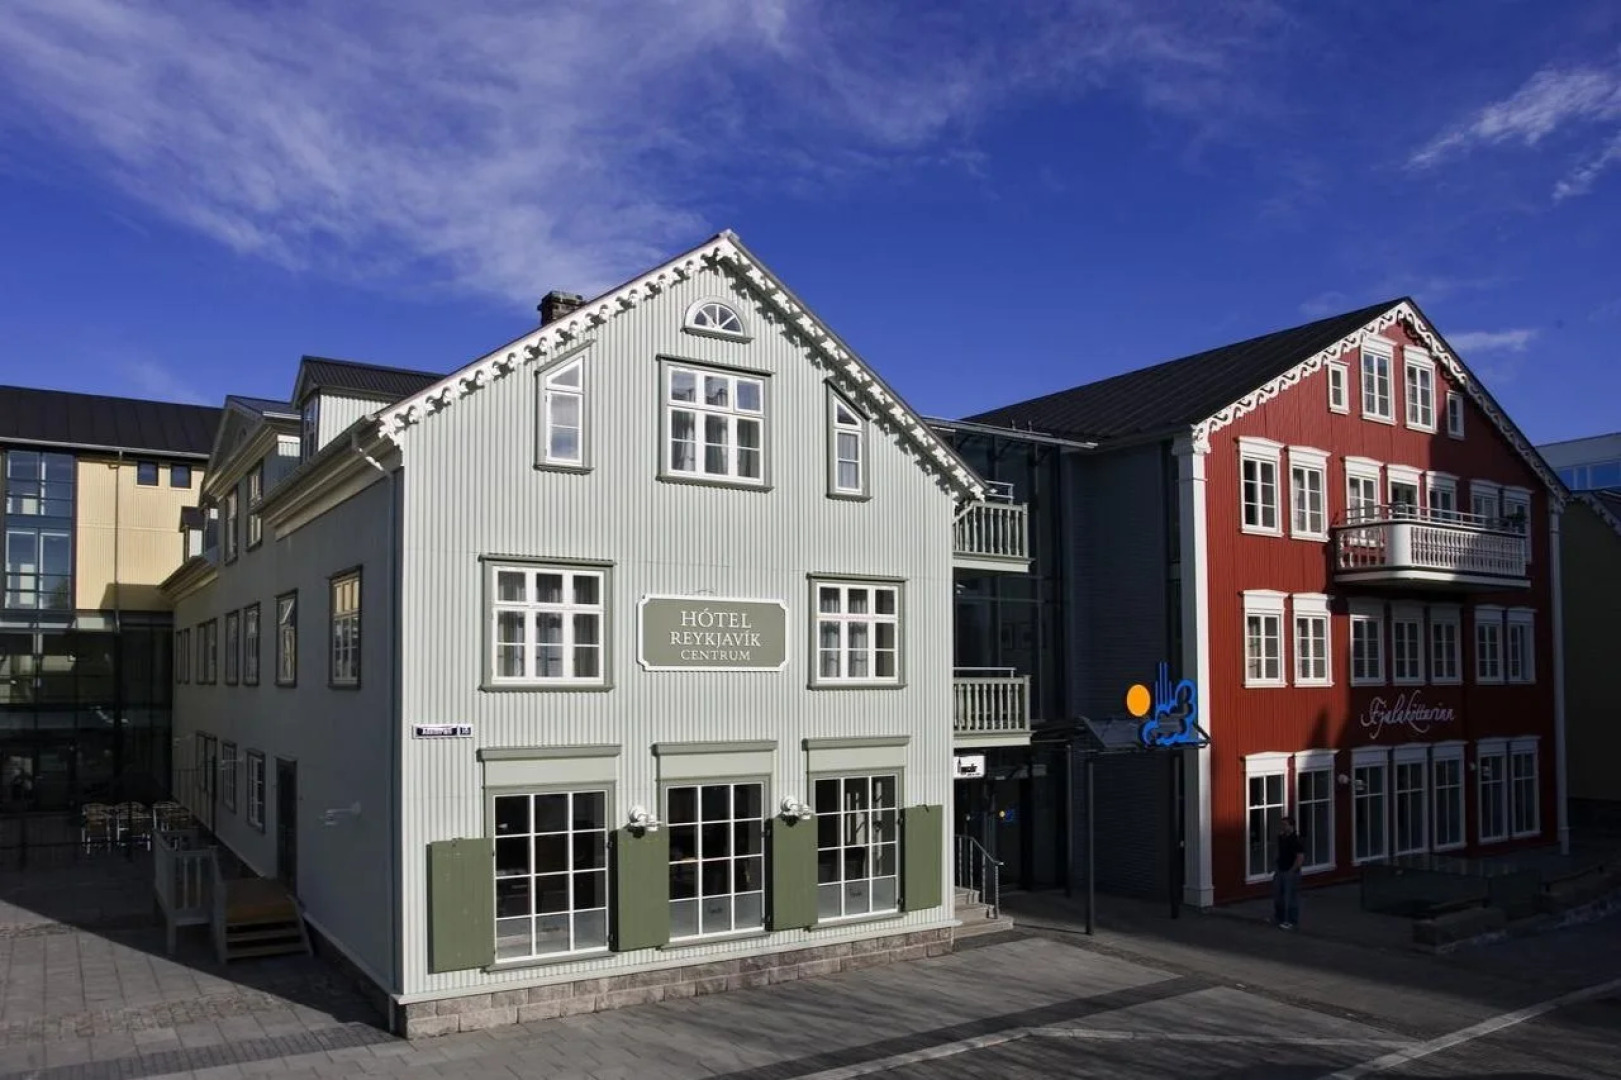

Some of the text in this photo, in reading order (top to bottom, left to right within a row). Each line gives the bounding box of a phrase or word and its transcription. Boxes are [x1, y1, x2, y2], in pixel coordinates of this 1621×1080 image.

[680, 608, 752, 629] HÓTEL
[670, 630, 762, 648] REYKJAVÍK
[680, 650, 751, 661] CENTRUM
